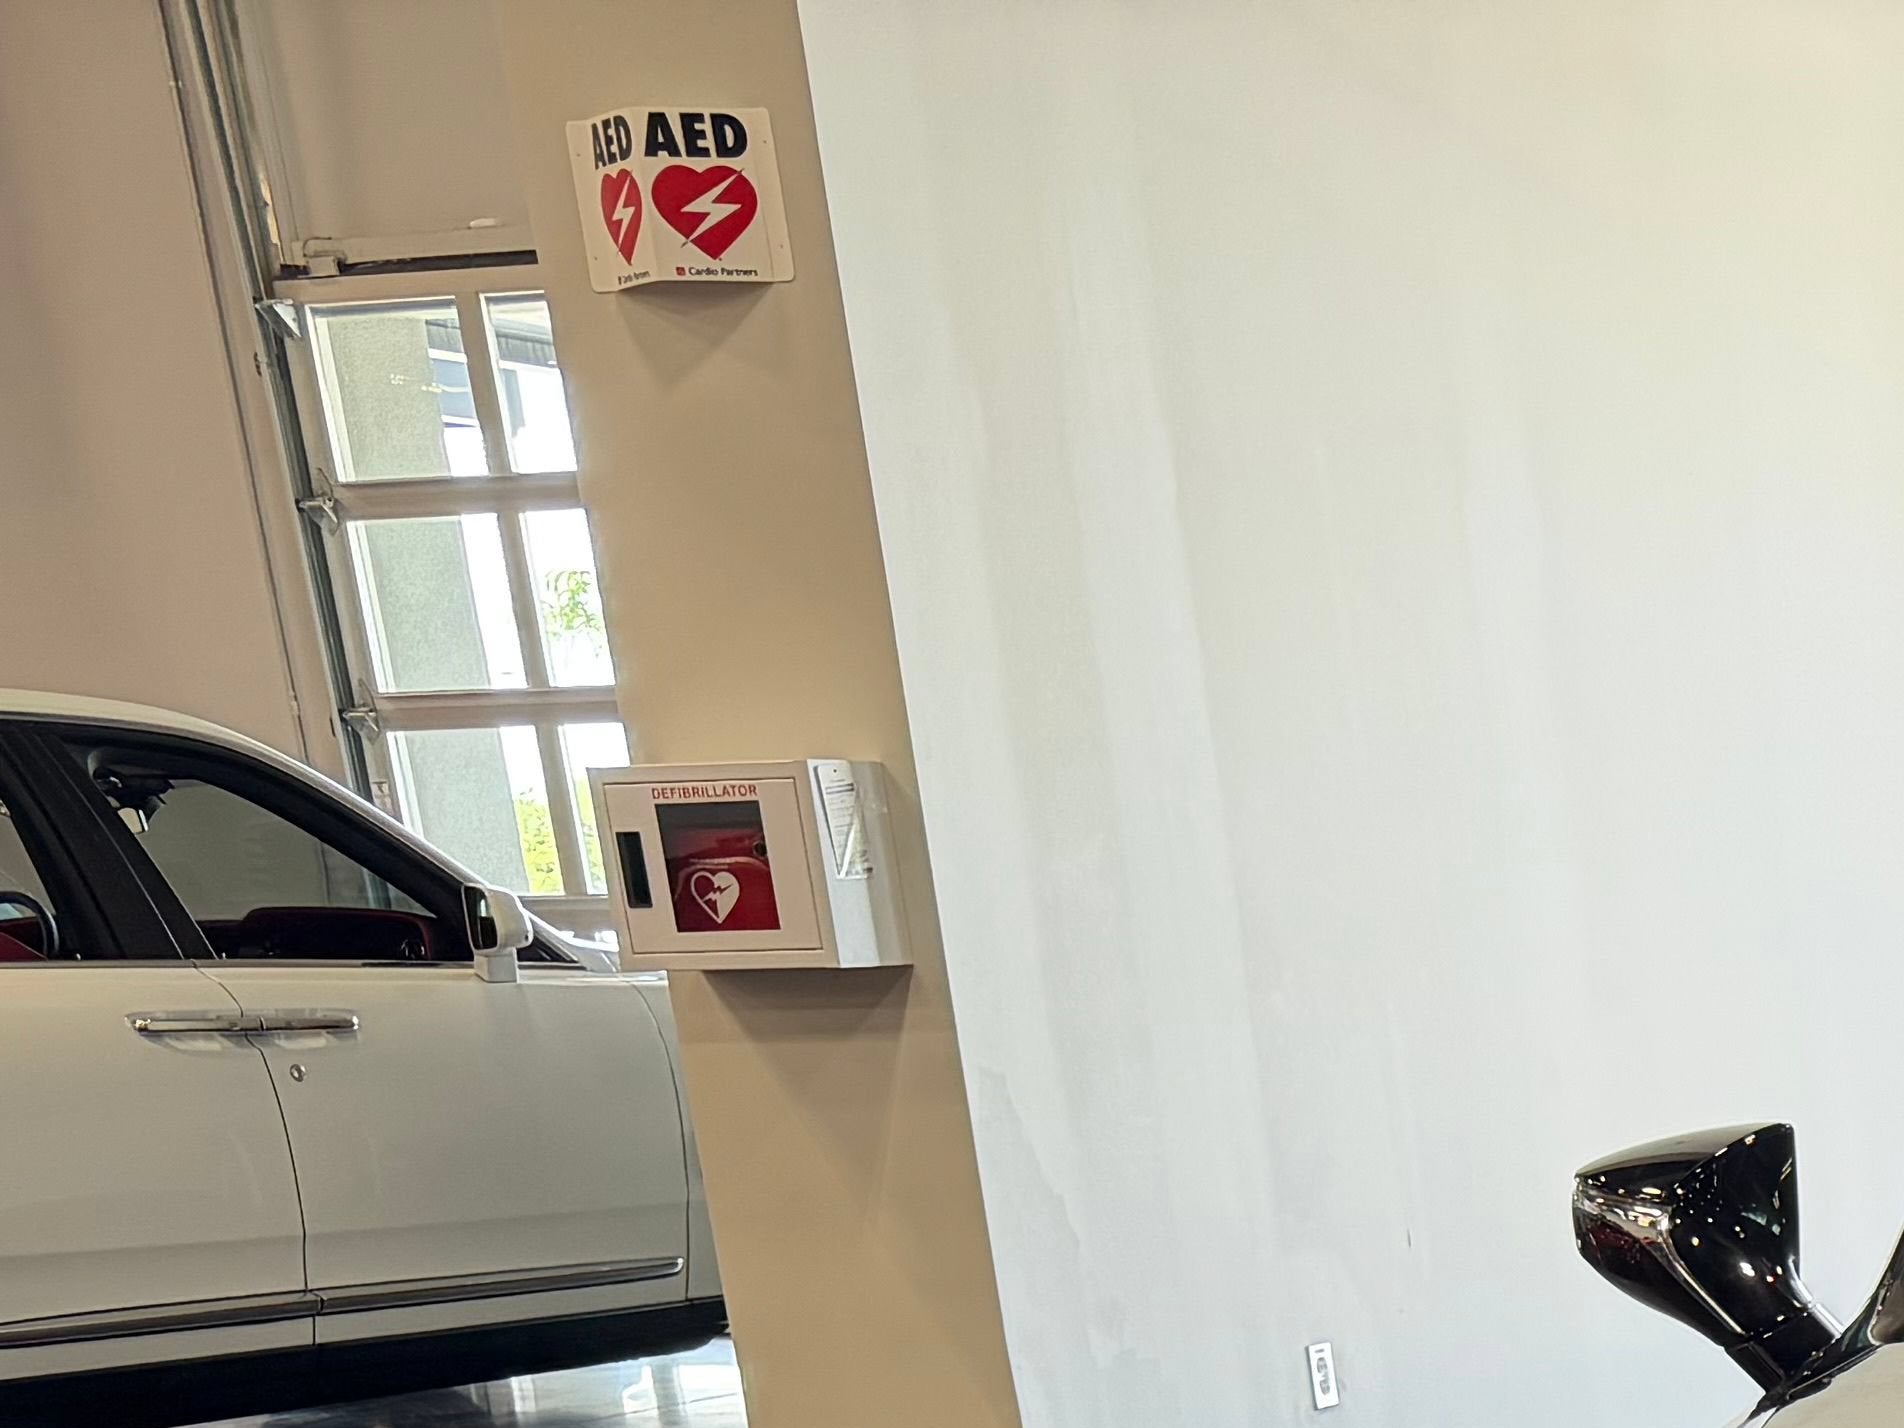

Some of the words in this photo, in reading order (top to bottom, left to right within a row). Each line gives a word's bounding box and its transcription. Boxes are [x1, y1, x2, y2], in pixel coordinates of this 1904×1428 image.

[591, 115, 633, 170] AED
[644, 112, 748, 158] AED
[688, 267, 719, 276] Cardio
[721, 267, 759, 277] Partners
[651, 784, 758, 799] DEFIBRILLATOR
